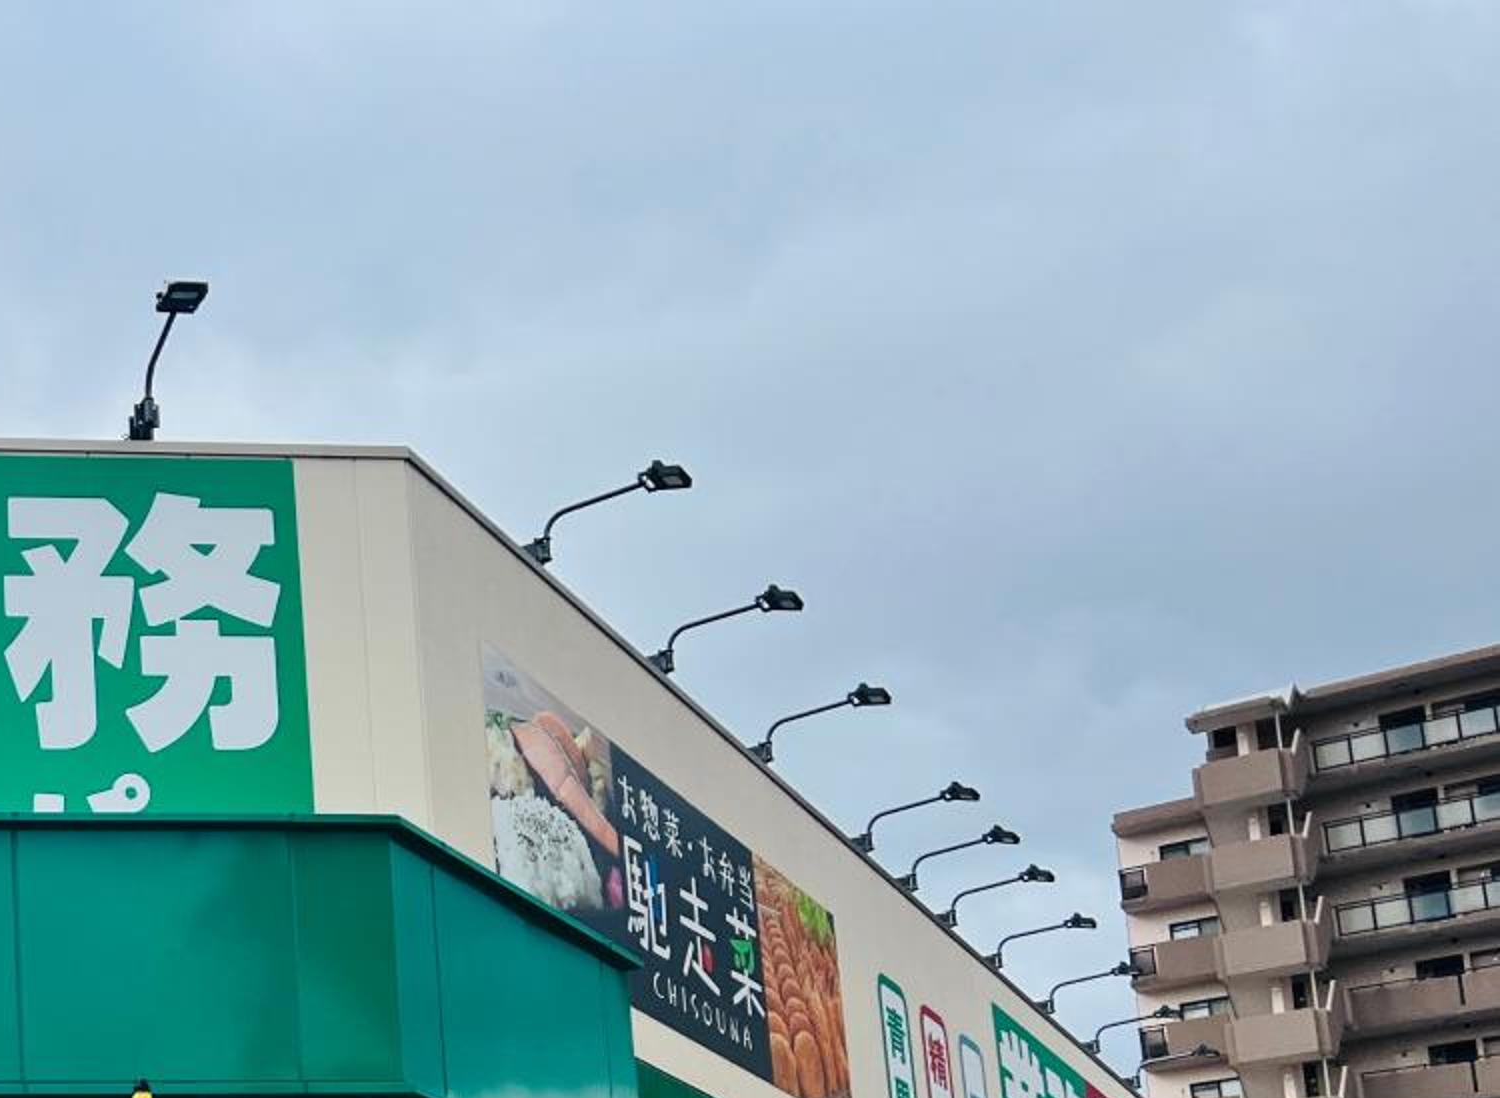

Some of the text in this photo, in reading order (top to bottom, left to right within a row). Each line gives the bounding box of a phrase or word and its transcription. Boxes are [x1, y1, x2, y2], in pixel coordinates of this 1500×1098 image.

[616, 774, 755, 914] お惣菜・お弁当
[622, 834, 766, 1018] 馳走菜
[652, 971, 754, 1052] CHISOUNA
